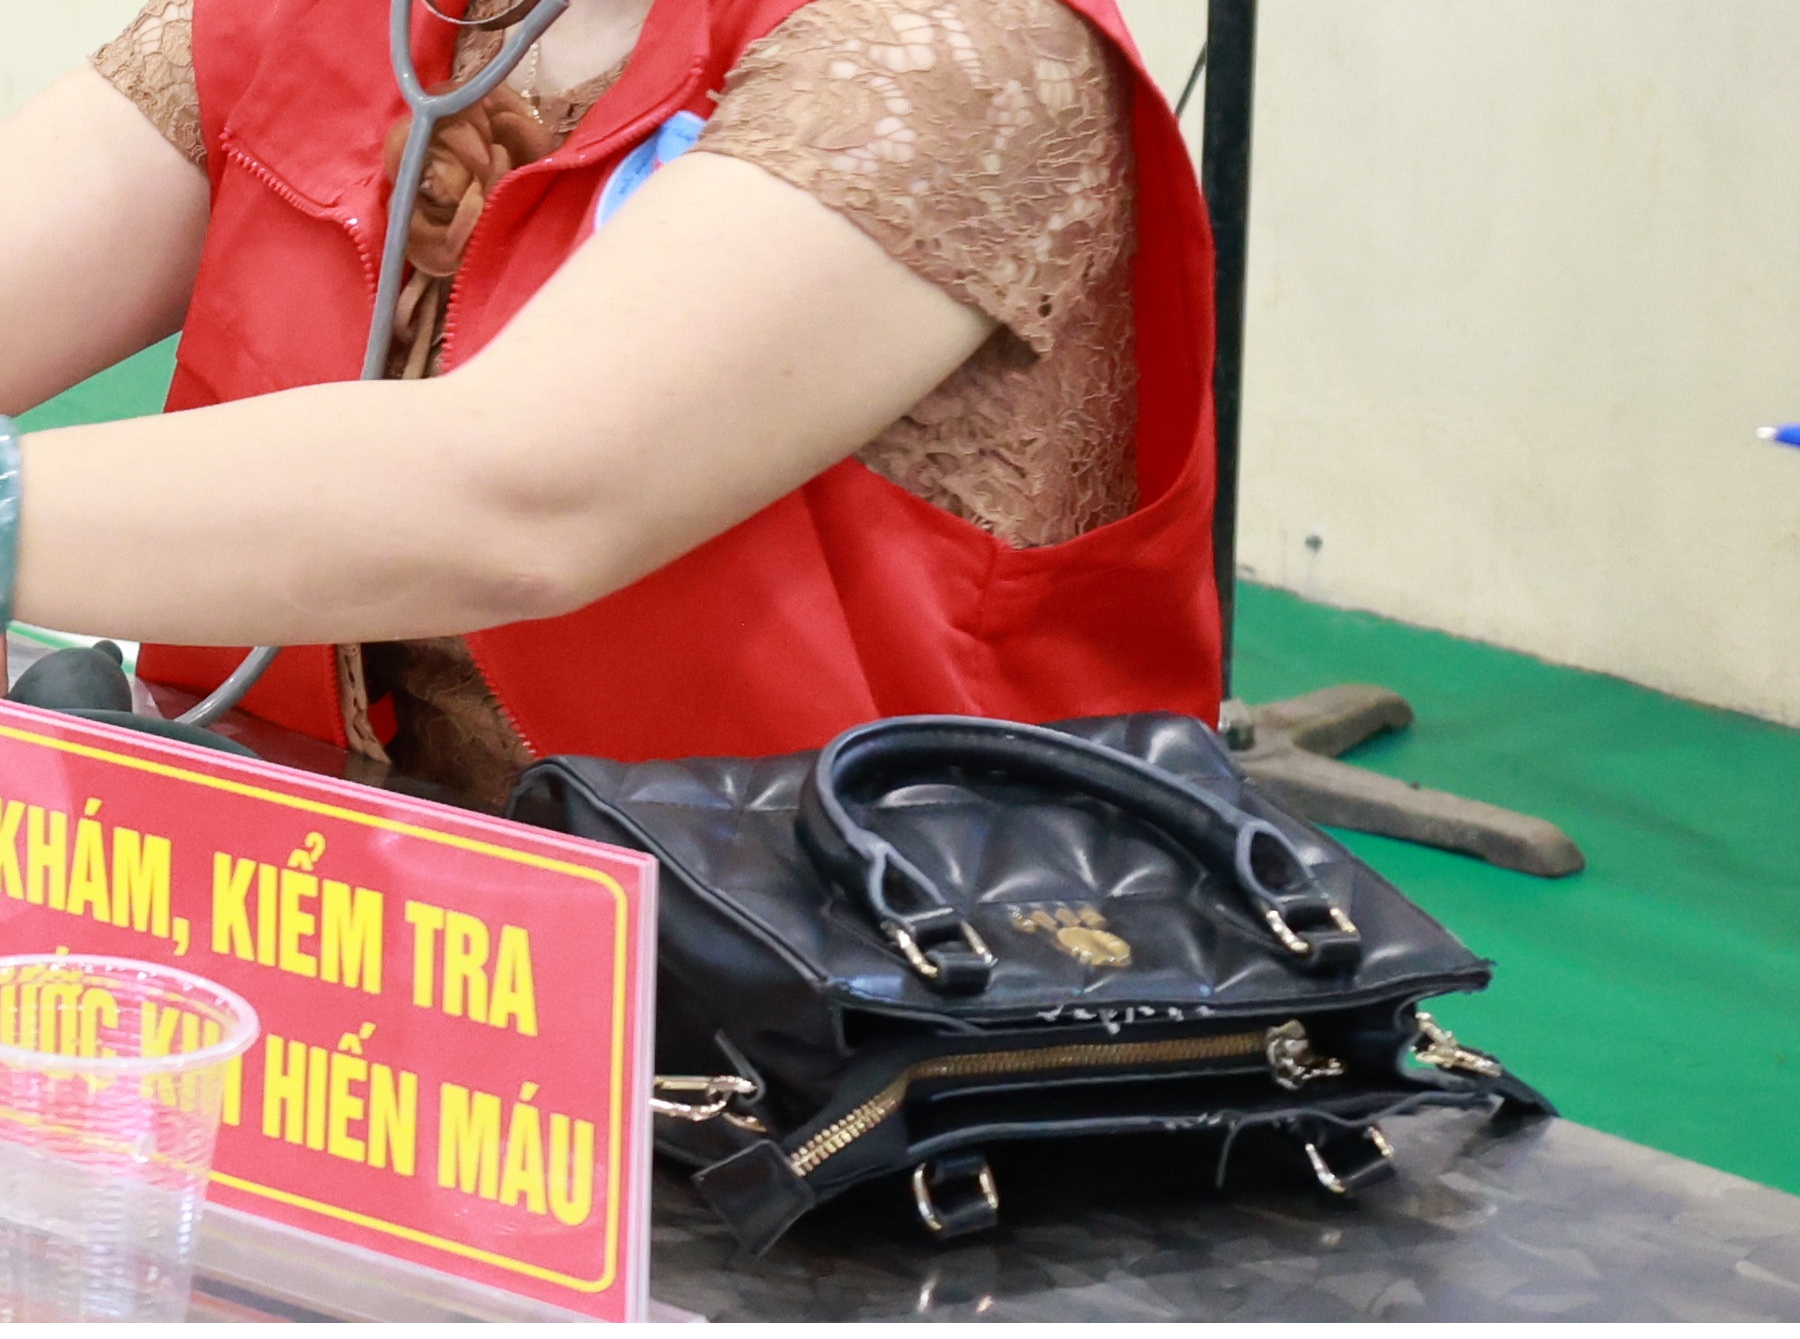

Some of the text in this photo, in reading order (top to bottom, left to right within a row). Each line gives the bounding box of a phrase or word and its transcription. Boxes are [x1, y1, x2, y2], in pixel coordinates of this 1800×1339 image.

[211, 833, 385, 995] KIỂM
[405, 900, 539, 1037] TRA
[261, 1022, 420, 1177] HIẾN
[437, 1080, 596, 1227] MÁU
